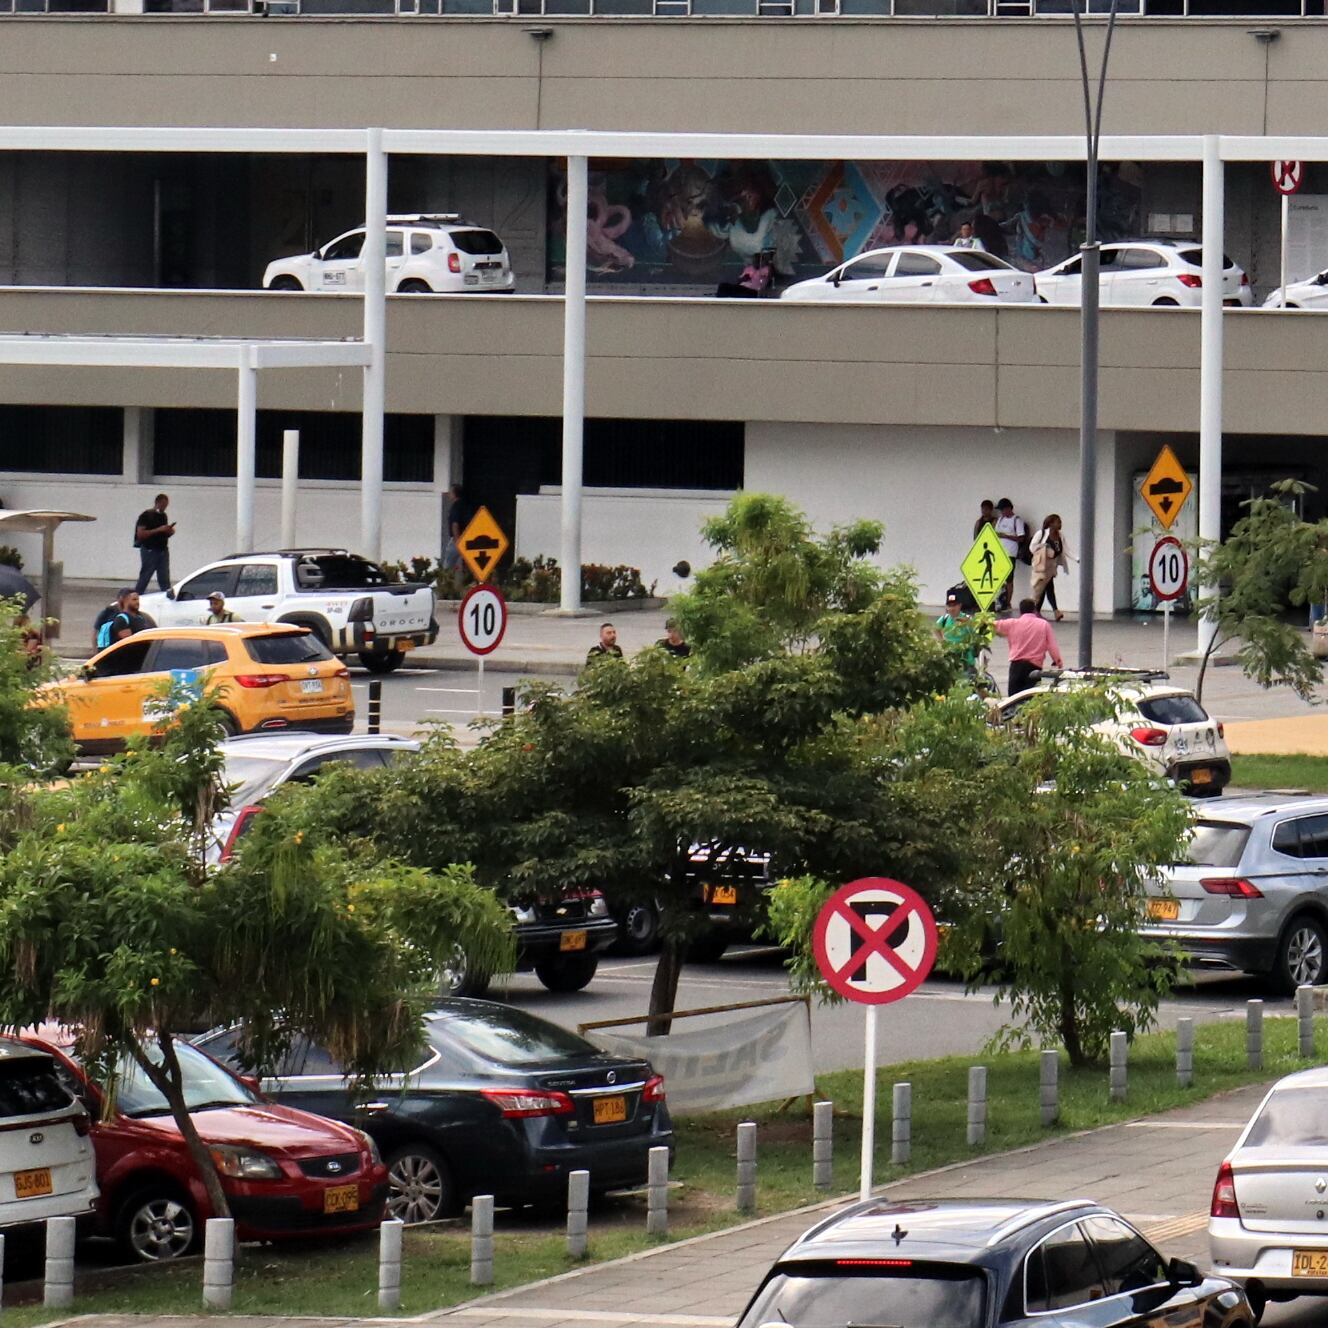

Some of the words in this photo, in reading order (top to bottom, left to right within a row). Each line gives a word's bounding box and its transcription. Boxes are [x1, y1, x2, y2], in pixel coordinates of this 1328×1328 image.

[1158, 553, 1179, 584] 10
[379, 617, 424, 627] OROCH
[471, 603, 496, 638] 10
